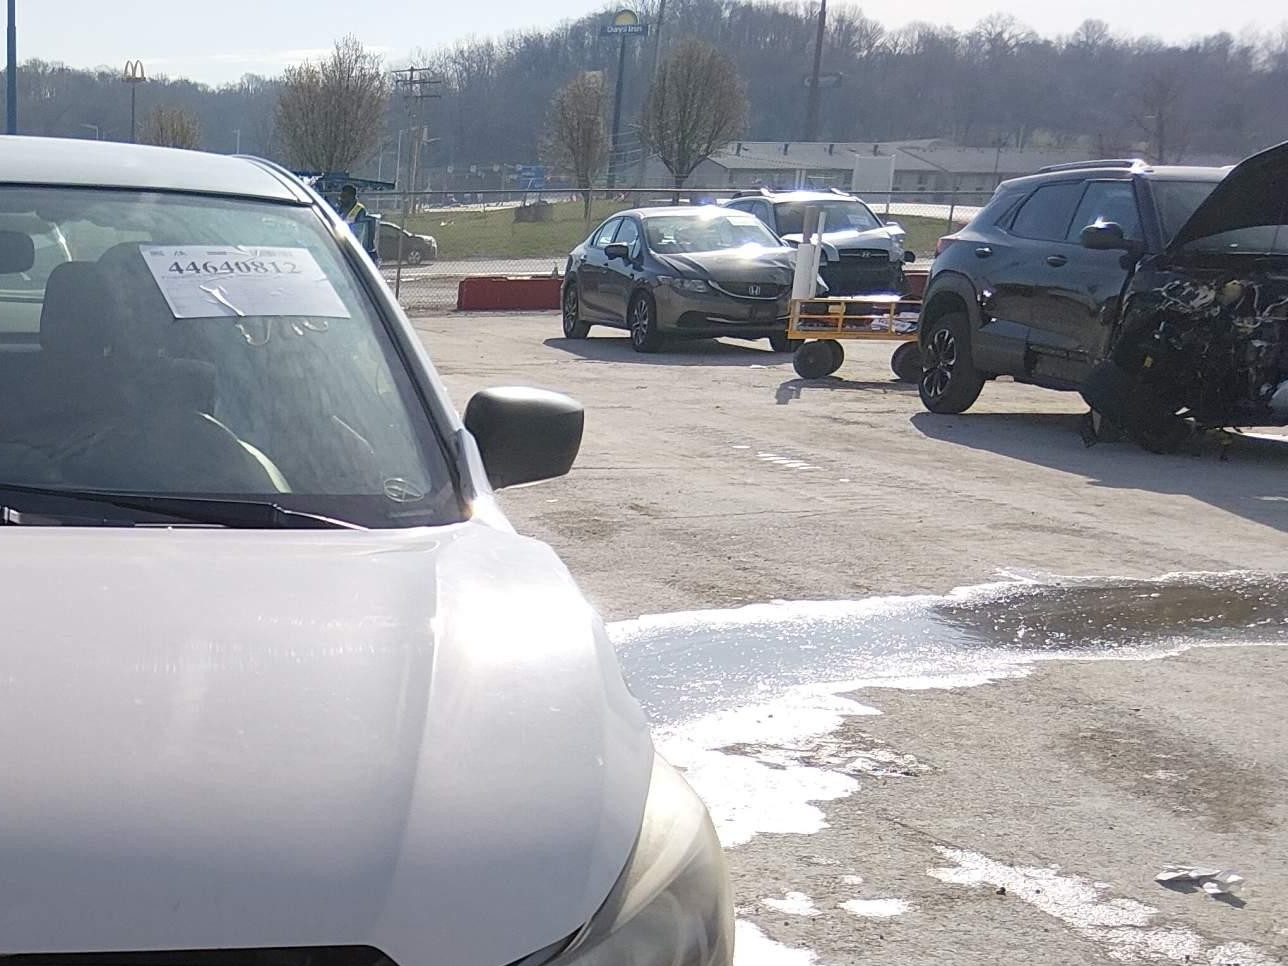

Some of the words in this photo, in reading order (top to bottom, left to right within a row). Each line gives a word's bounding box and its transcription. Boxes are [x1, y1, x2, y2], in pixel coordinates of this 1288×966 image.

[607, 25, 627, 33] Days
[628, 25, 643, 33] Inn
[168, 260, 302, 275] 44640812
